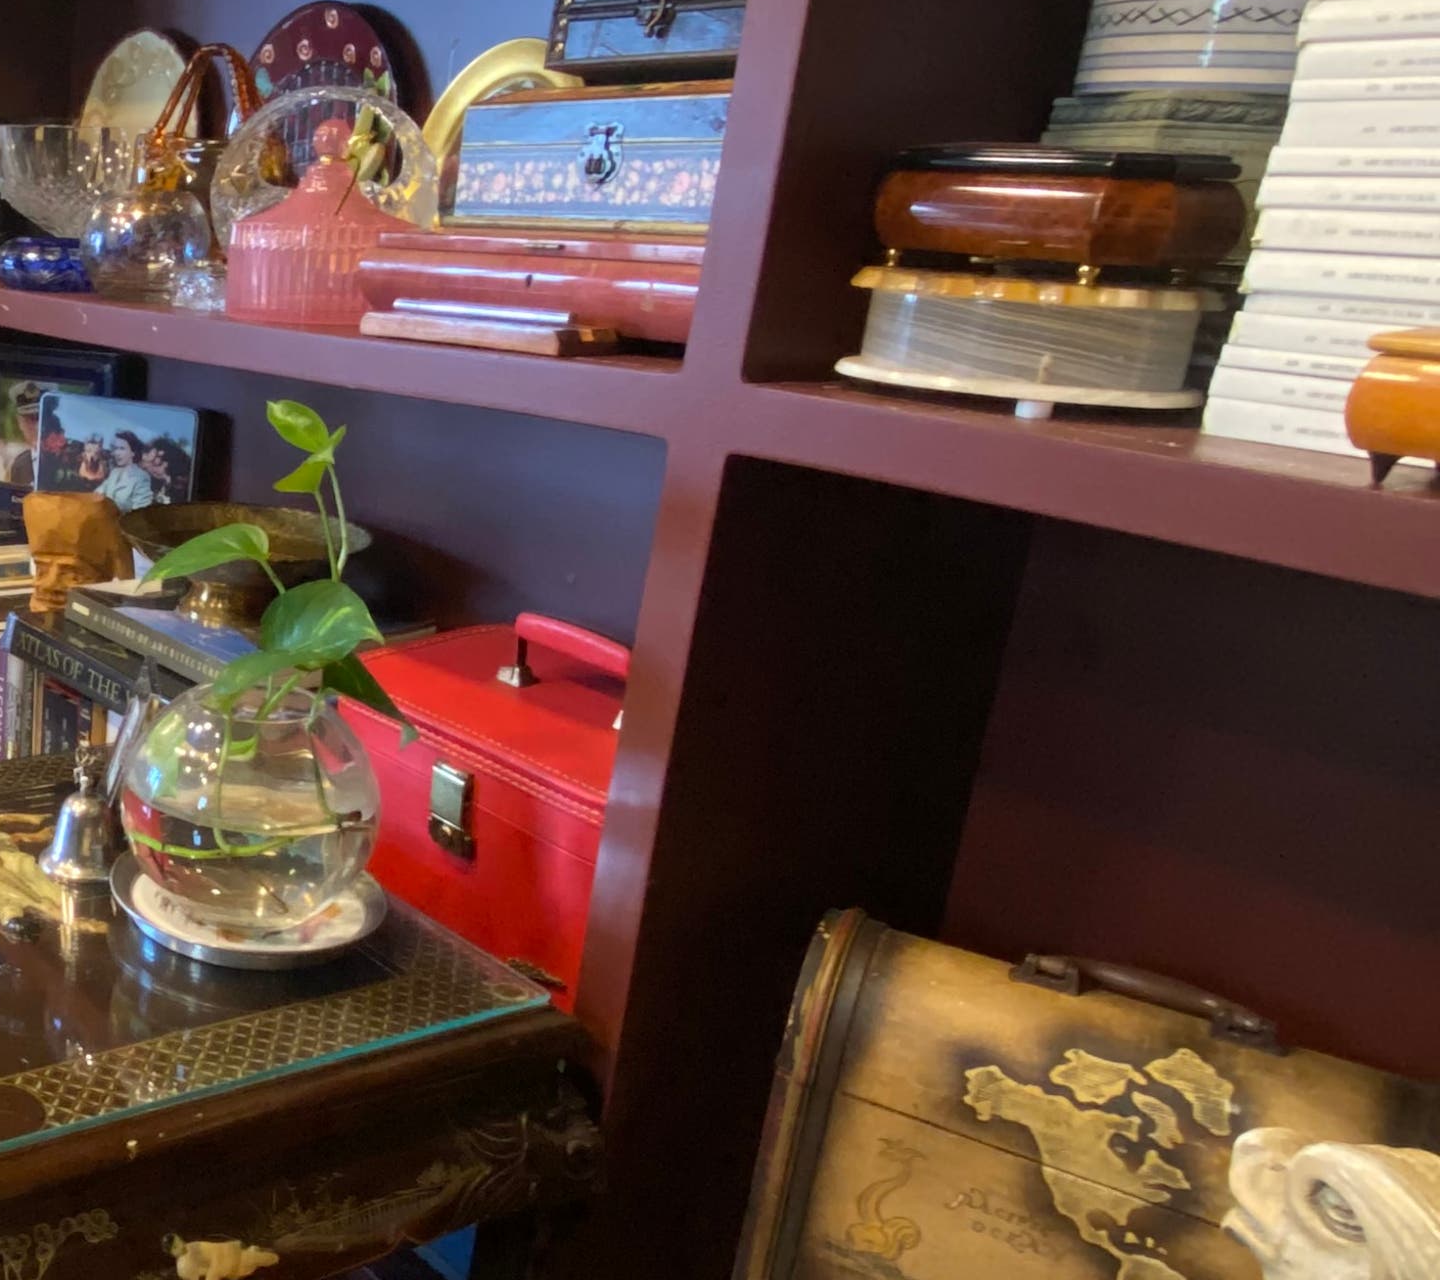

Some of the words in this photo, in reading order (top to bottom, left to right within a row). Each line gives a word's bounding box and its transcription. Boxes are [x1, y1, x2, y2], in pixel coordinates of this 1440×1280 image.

[17, 630, 60, 670] ATLAS
[62, 656, 85, 681] OF
[87, 667, 121, 703] THE
